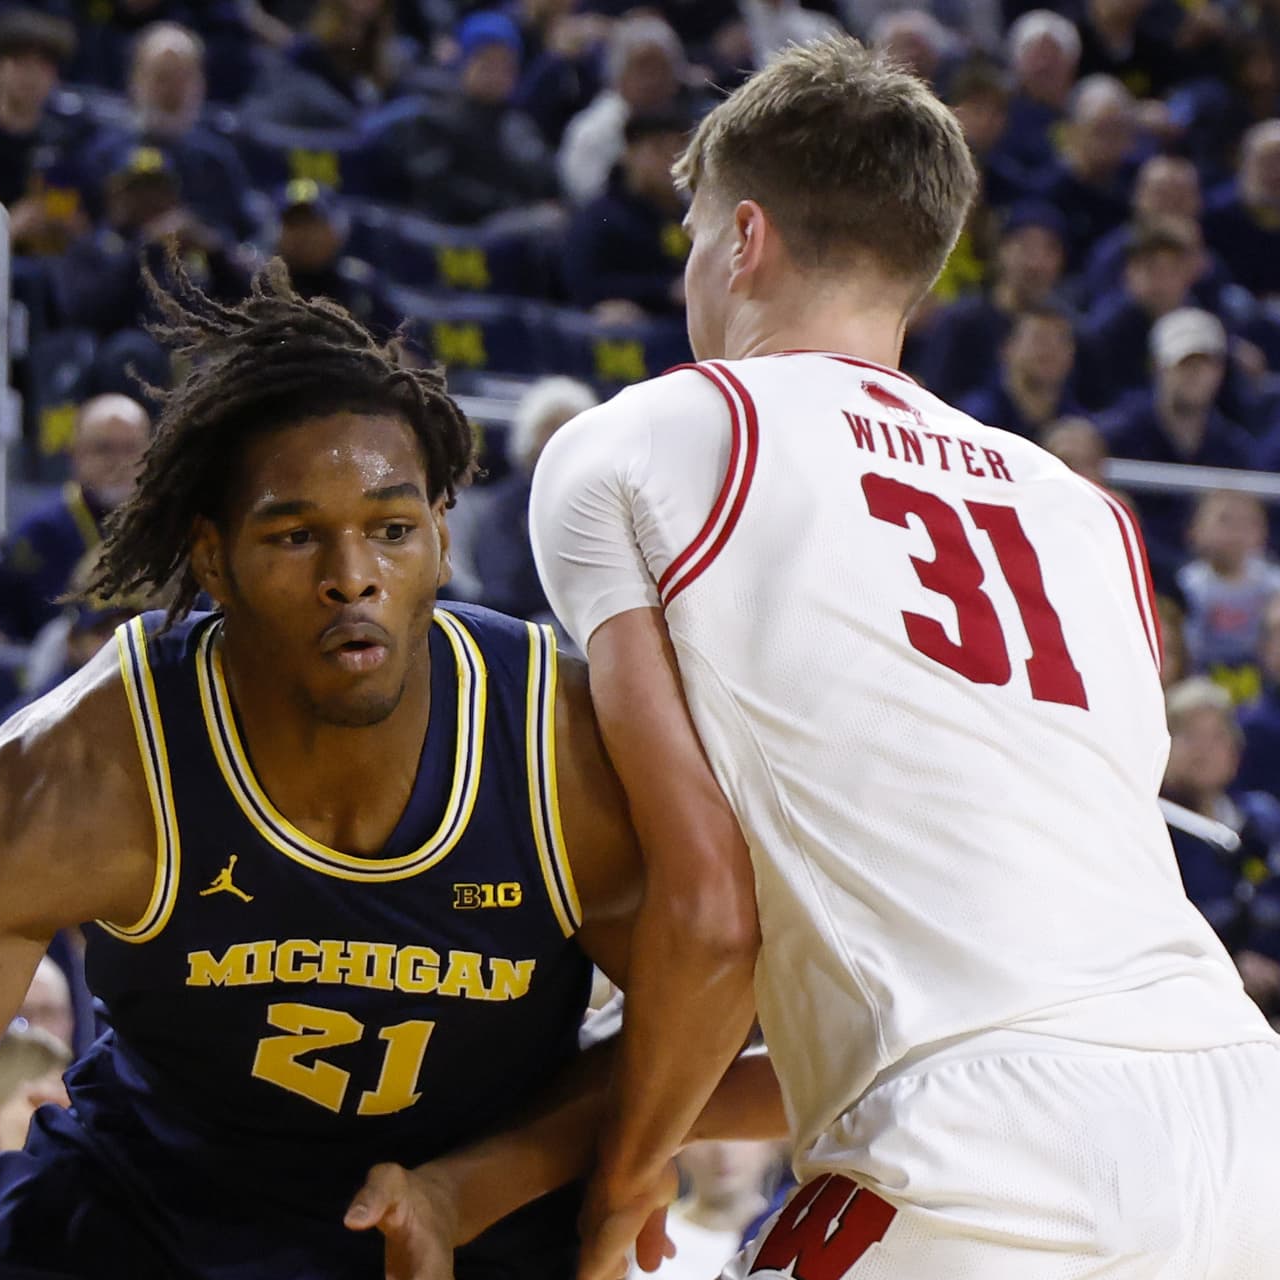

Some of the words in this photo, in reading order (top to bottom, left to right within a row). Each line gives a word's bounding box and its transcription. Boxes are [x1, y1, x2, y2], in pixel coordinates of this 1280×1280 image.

[841, 409, 1015, 483] WINTER
[860, 471, 1090, 712] 31
[184, 938, 537, 1002] MICHIGAN
[250, 1001, 437, 1116] 21
